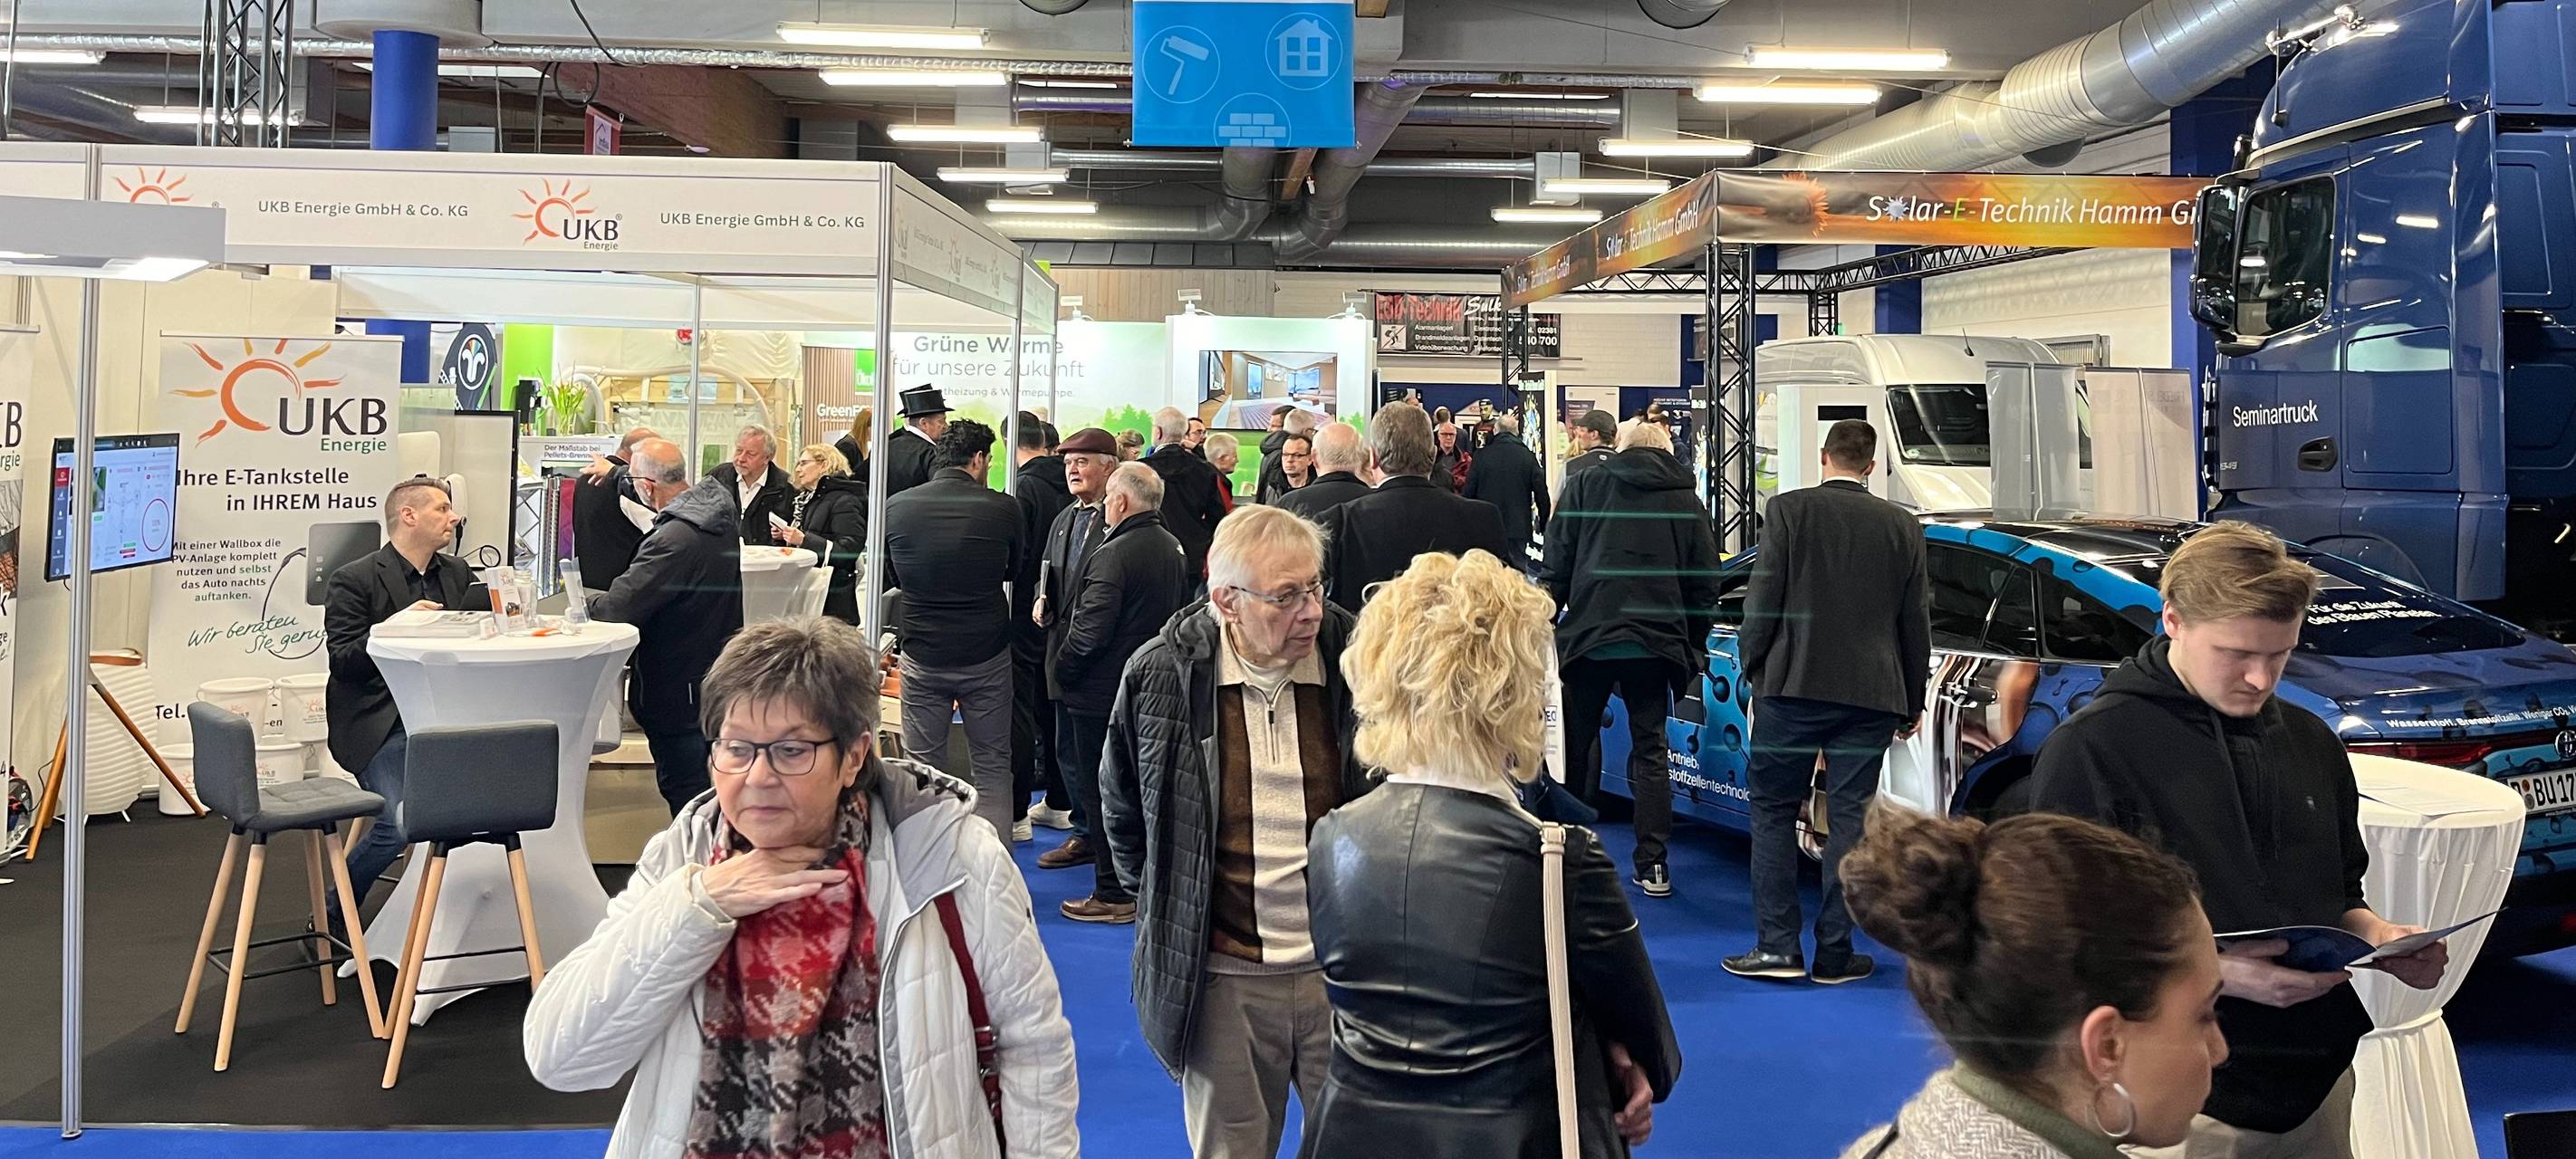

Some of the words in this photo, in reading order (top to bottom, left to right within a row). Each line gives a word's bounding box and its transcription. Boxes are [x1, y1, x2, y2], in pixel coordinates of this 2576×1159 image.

[258, 200, 290, 214] UKB
[294, 201, 351, 217] Energie
[355, 203, 401, 216] GmbH
[405, 204, 416, 216] &
[419, 204, 444, 217] Co.
[447, 205, 469, 217] KG
[2079, 198, 2162, 225] Hamm
[2170, 199, 2196, 225] G
[659, 212, 691, 225] UKB
[696, 213, 750, 228] Energie
[754, 214, 800, 227] GmbH
[803, 216, 813, 227] &
[817, 216, 841, 228] Co.
[844, 216, 866, 229] KG
[1675, 199, 1699, 236] GmbH
[562, 217, 620, 242] UKB
[582, 241, 620, 252] Energie
[1414, 324, 1454, 333] Alarmanlagen
[913, 335, 979, 353] Grüne
[986, 337, 1064, 354] Wrme
[1415, 334, 1470, 343] Brandmeldeanlagen
[1539, 336, 1558, 346] 700
[1415, 344, 1469, 352] Videoüberwachung
[891, 356, 920, 377] für
[927, 362, 997, 377] unsere
[943, 387, 988, 398] theizung
[991, 388, 997, 398] &
[278, 398, 388, 436] UKB
[2233, 398, 2319, 427] Seminartruck
[321, 436, 387, 455] Energie
[544, 444, 557, 452] Der
[590, 444, 601, 452] bei
[178, 469, 218, 486] Ihre
[226, 467, 350, 486] E-Tankstelle
[226, 494, 245, 512] in
[253, 493, 320, 511] IHREM
[328, 493, 377, 509] Haus
[189, 541, 216, 550] einer
[220, 539, 263, 549] Wallbox
[264, 539, 281, 548] die
[172, 552, 226, 563] PV-Anlage
[229, 551, 277, 563] komplett
[177, 567, 213, 577] nutzen
[216, 566, 236, 575] und
[239, 564, 272, 574] selbst
[181, 580, 200, 589] das
[203, 579, 227, 589] Auto
[230, 577, 266, 587] nachts
[194, 591, 252, 602] auftanken.
[2307, 615, 2338, 626] des
[2331, 611, 2380, 622] Blauen
[187, 628, 223, 647] Wir
[245, 634, 274, 654] Sie
[155, 703, 186, 721] Tel.
[2385, 717, 2457, 729] Wasserstoff.
[2456, 713, 2522, 726] Brennstoffzelle.
[2521, 709, 2553, 721] Weniger
[2533, 776, 2557, 806] BU
[2556, 772, 2576, 803] 17
